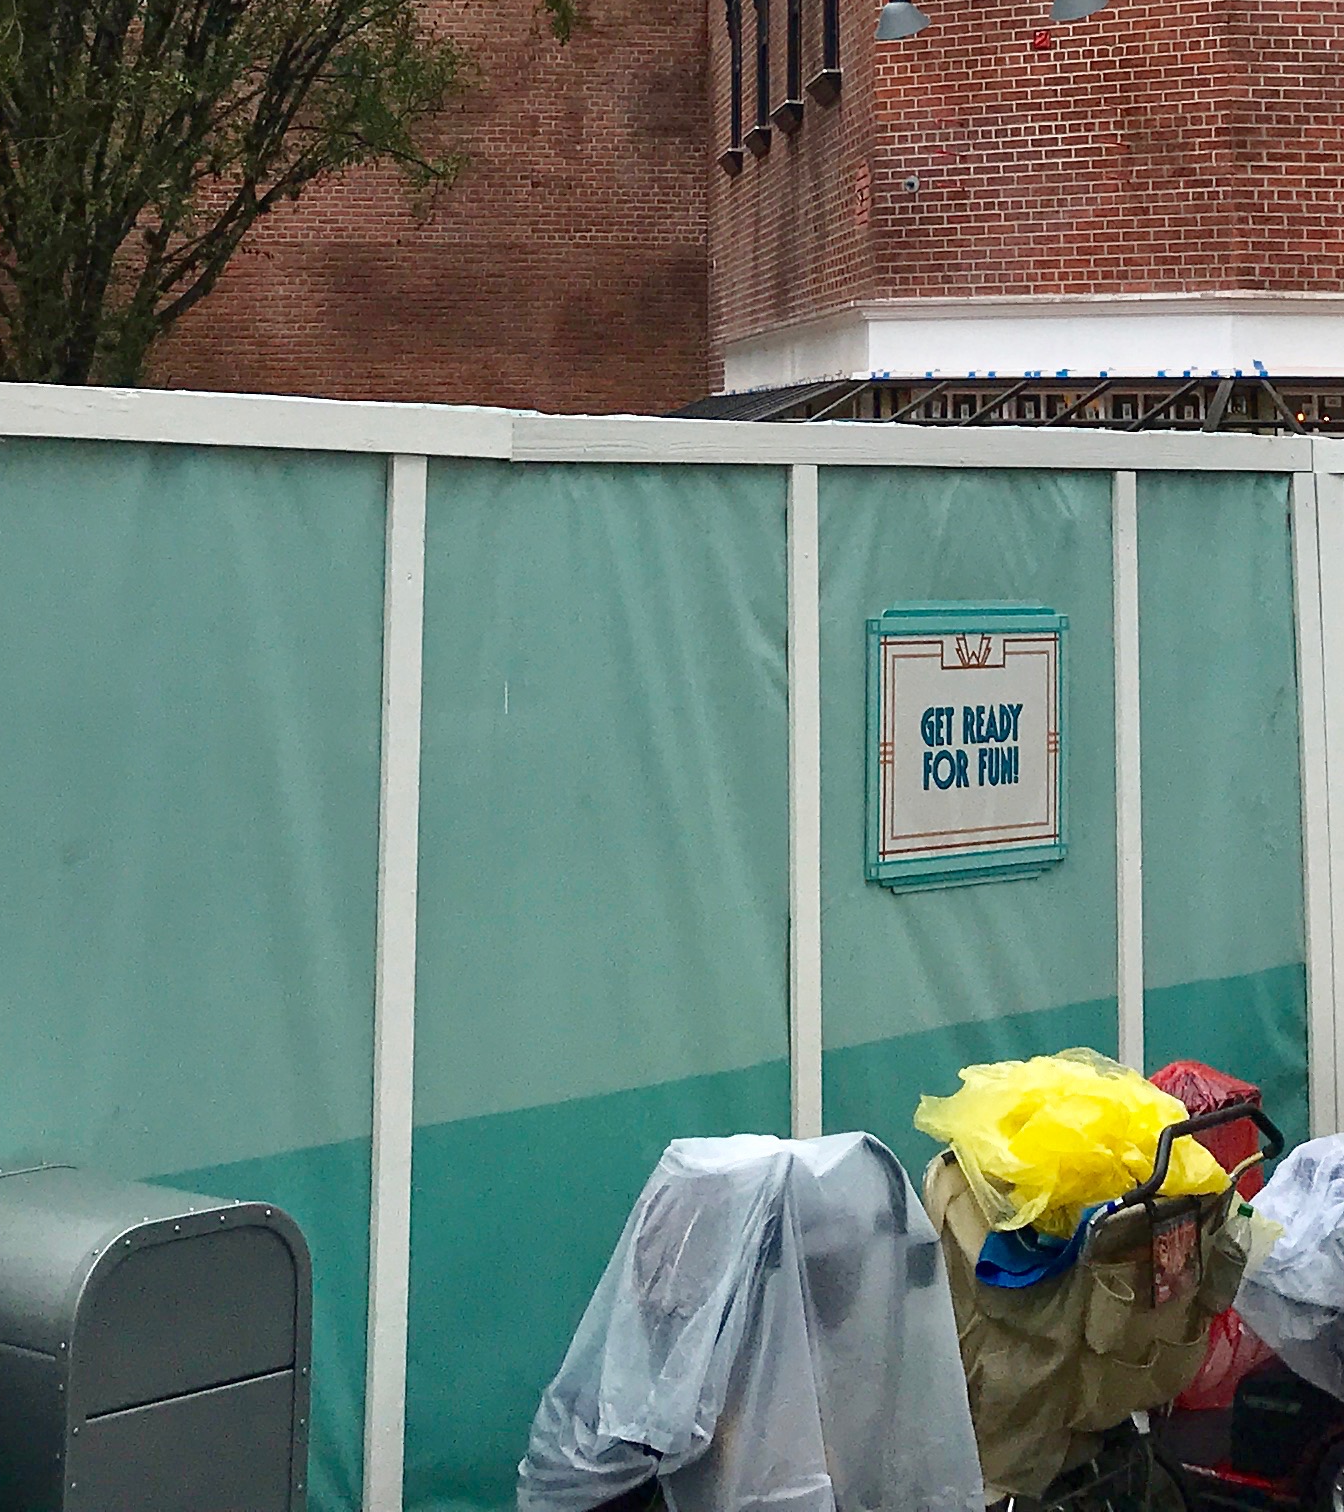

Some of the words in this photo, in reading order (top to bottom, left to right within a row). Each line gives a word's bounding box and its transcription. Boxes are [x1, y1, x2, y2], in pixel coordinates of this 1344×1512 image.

[921, 707, 954, 746] GET
[963, 704, 1023, 743] READY
[923, 749, 969, 790] FOR
[978, 746, 1019, 786] FUN!
